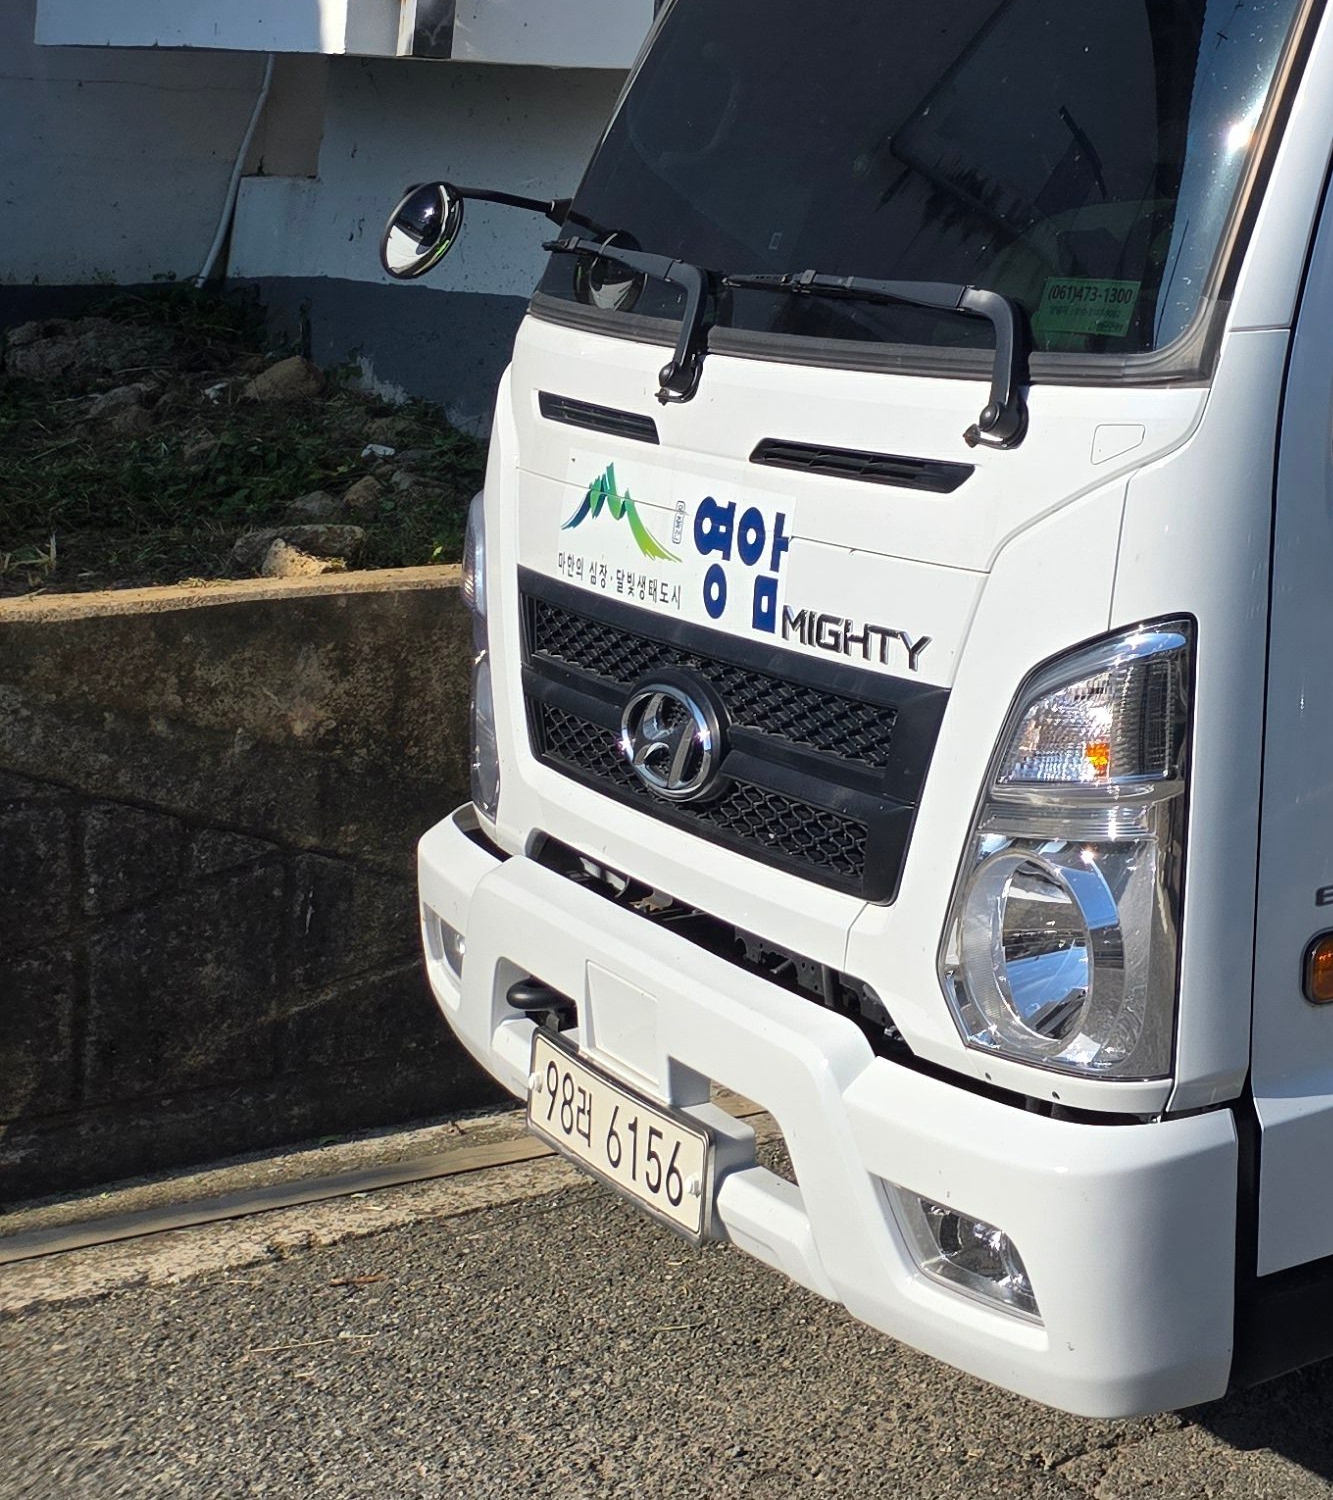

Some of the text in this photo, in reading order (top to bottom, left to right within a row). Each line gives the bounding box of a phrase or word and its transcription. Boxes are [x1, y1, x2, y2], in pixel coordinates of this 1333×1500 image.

[1048, 284, 1134, 305] (061)473-1300
[557, 552, 584, 581] 마한의
[693, 496, 791, 633] 영암
[782, 603, 933, 671] MIGHTY
[606, 1105, 684, 1207] 6156
